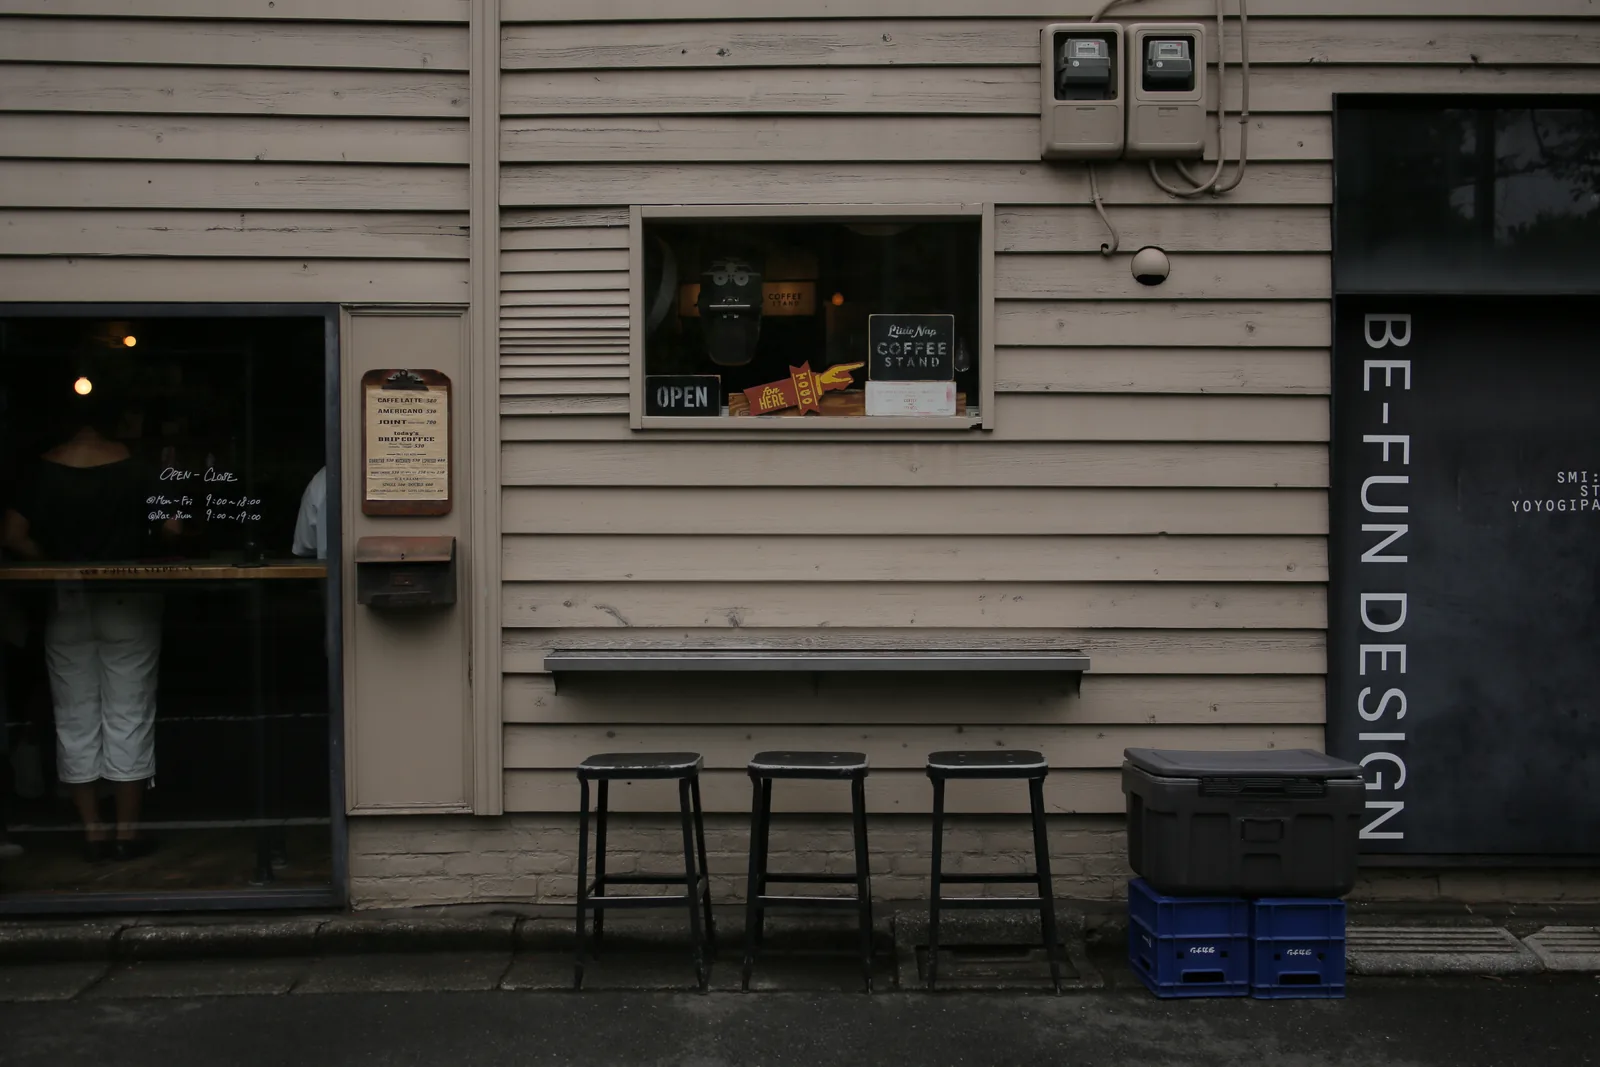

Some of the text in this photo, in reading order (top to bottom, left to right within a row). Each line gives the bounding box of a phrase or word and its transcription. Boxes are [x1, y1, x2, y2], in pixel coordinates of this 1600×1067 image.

[888, 324, 937, 338] Little Nap
[877, 341, 947, 355] COFFEE
[884, 357, 940, 367] STAND
[656, 385, 708, 408] OPEN
[759, 393, 786, 410] HERE
[160, 466, 192, 481] OPEN
[203, 466, 238, 482] CLOSE
[1580, 484, 1600, 497] ST
[1511, 499, 1600, 512] YOYOGIPA
[1357, 313, 1411, 839] BE-FUN DESIGN
